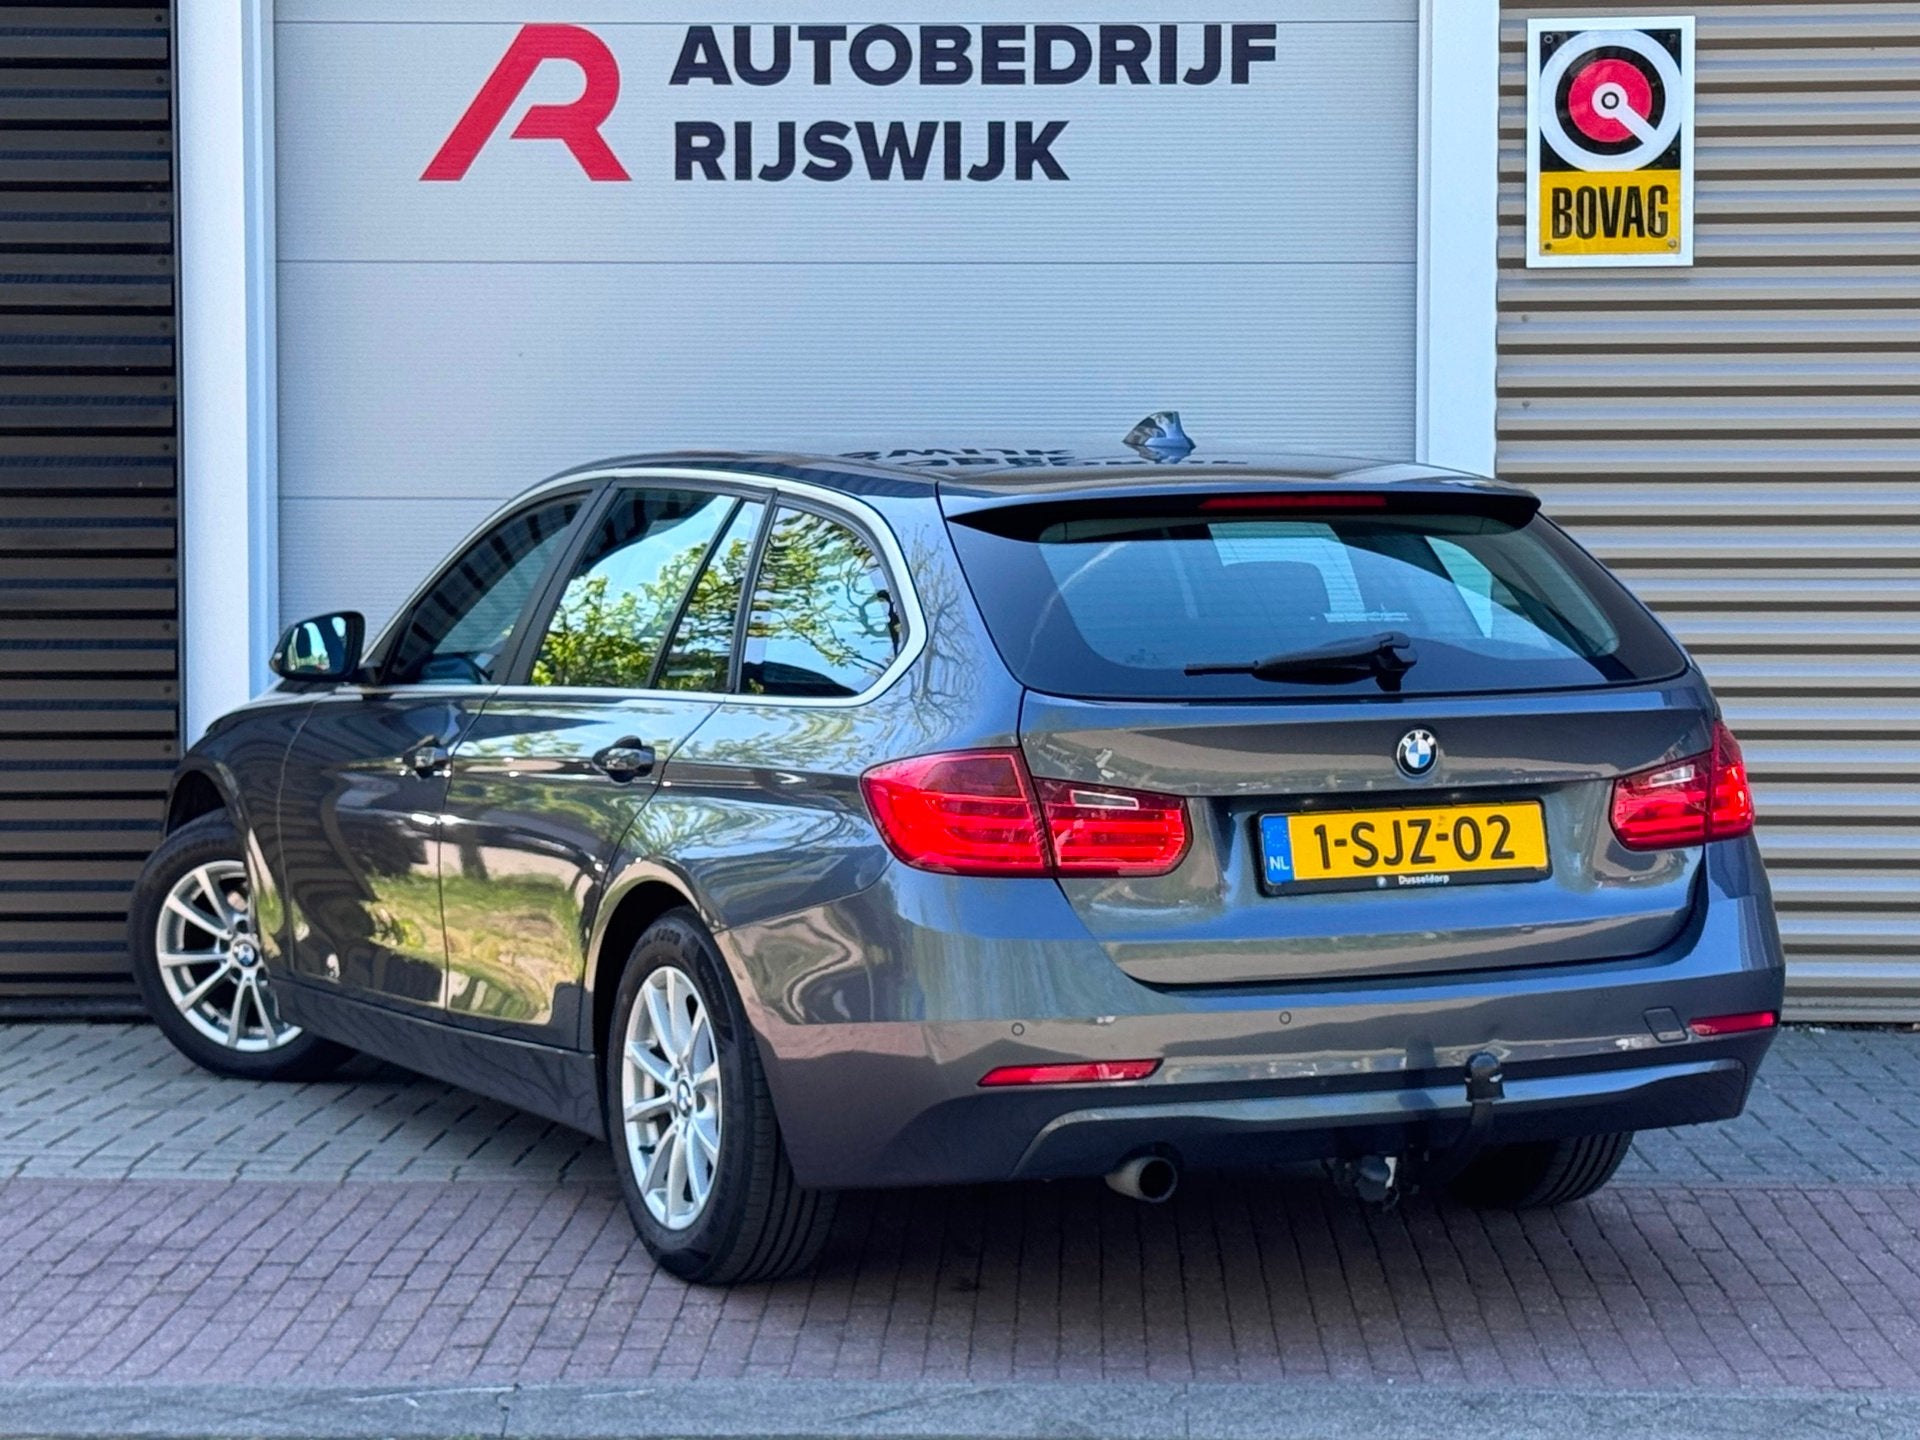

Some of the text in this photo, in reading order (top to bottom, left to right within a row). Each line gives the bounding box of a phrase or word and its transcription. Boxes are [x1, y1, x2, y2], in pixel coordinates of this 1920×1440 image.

[669, 24, 1277, 86] AUTOBEDRIJF
[674, 120, 1070, 182] RIJSWIJK
[1551, 184, 1669, 240] BOVAG
[1269, 856, 1290, 872] NL
[1313, 814, 1516, 870] 1-SJZ-02
